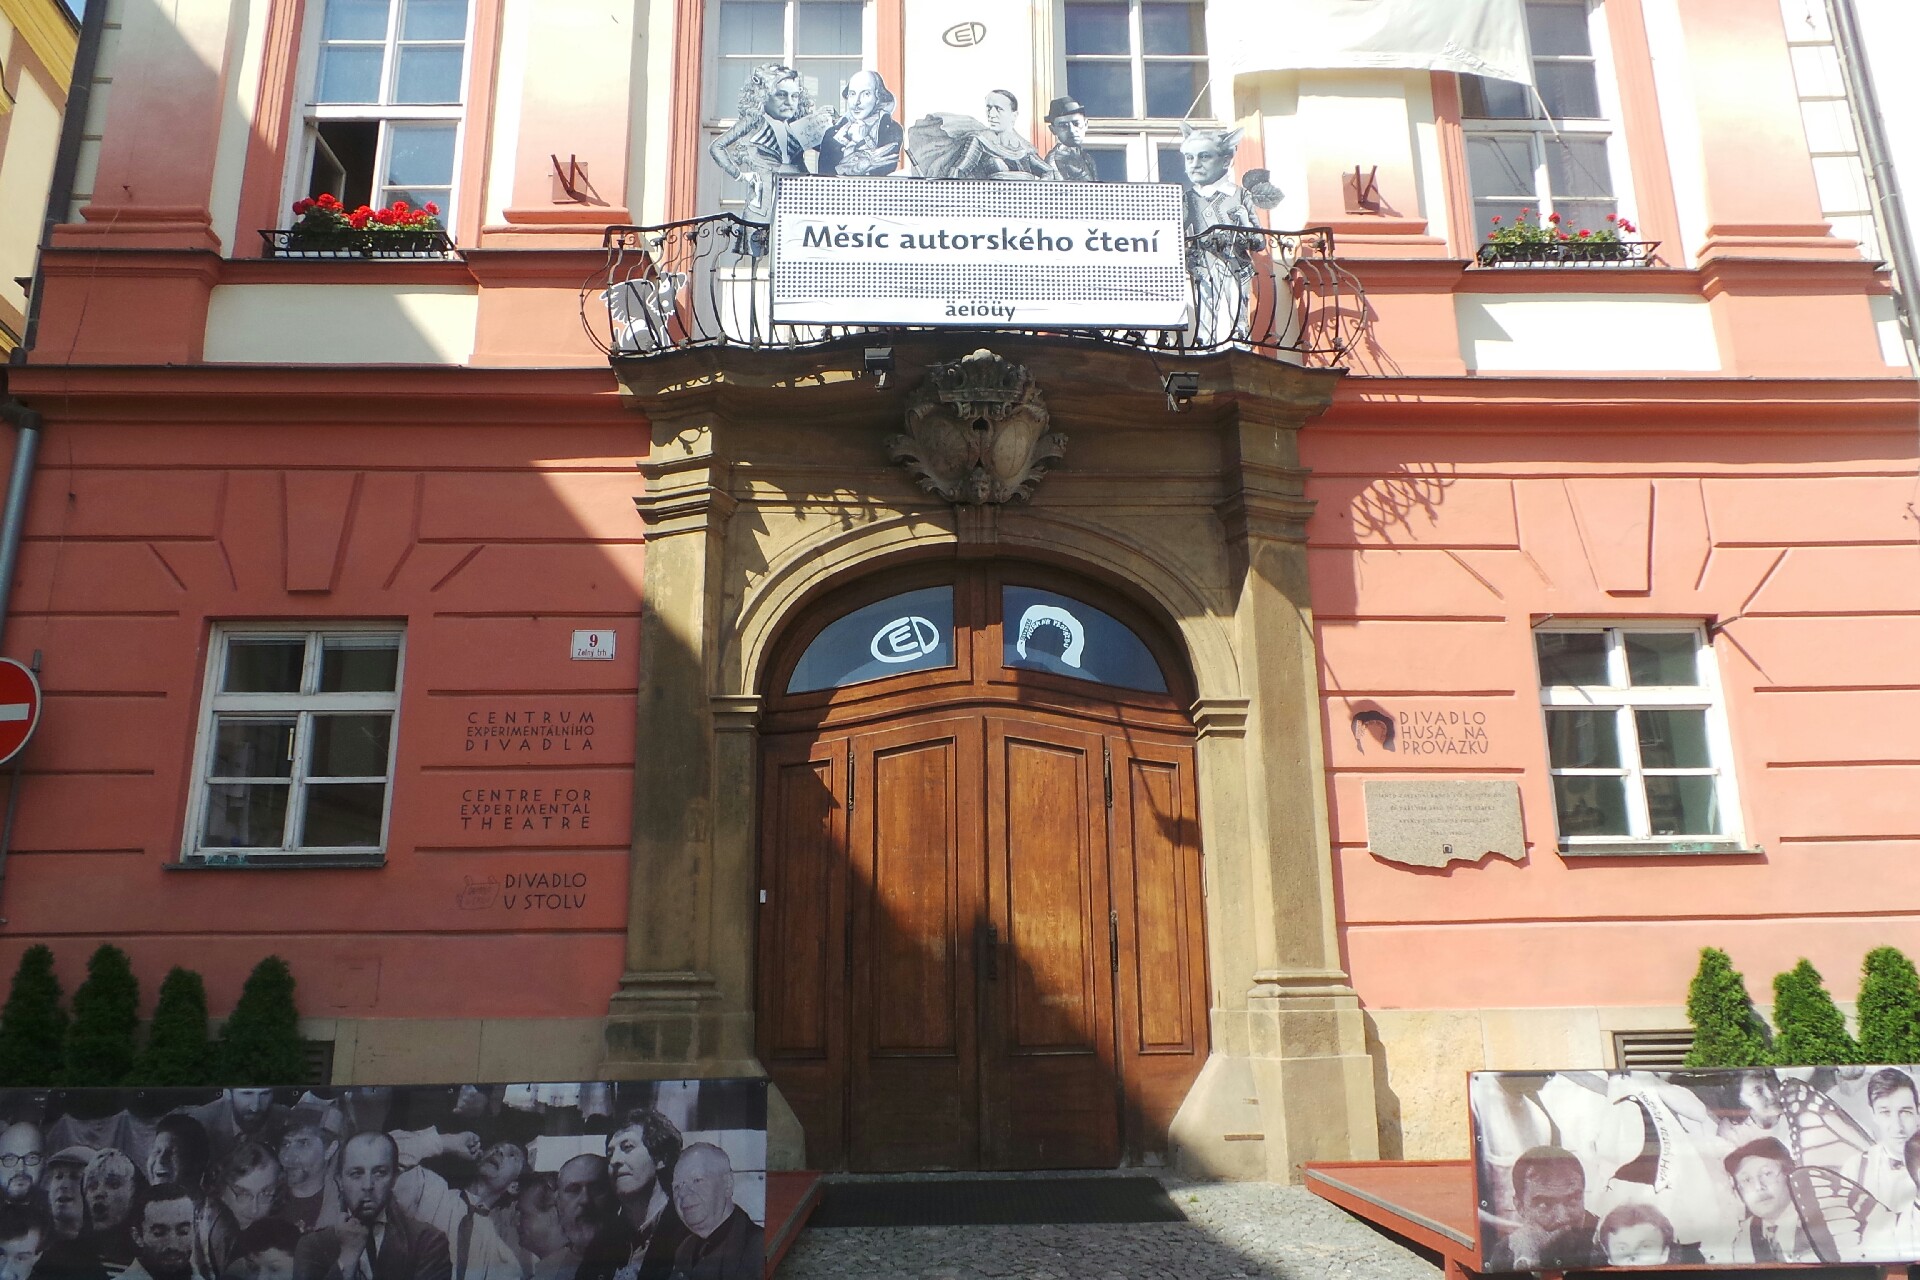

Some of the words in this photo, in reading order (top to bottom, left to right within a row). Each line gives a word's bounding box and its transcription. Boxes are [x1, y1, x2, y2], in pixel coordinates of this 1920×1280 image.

[802, 225, 889, 249] Měsíc
[900, 227, 1074, 251] autorského
[1085, 229, 1160, 253] čtení
[589, 634, 598, 647] 9
[598, 648, 607, 656] trh
[468, 711, 594, 724] CENTRUM
[1399, 711, 1486, 725] DIVADLO
[467, 723, 594, 737] EXPERIMENTÁLNÍHO
[1401, 726, 1447, 739] HUSA
[1464, 726, 1488, 740] NA
[466, 738, 593, 752] DIVADLA
[1403, 737, 1489, 755] PROVÁZKU
[462, 789, 542, 802] CENTRE
[554, 789, 591, 801] FOR
[461, 803, 590, 815] EXPERIMENTAL
[461, 816, 590, 830] THEATRE
[505, 873, 587, 888] DIVADLO
[504, 895, 516, 909] U
[524, 894, 586, 909] STOLU
